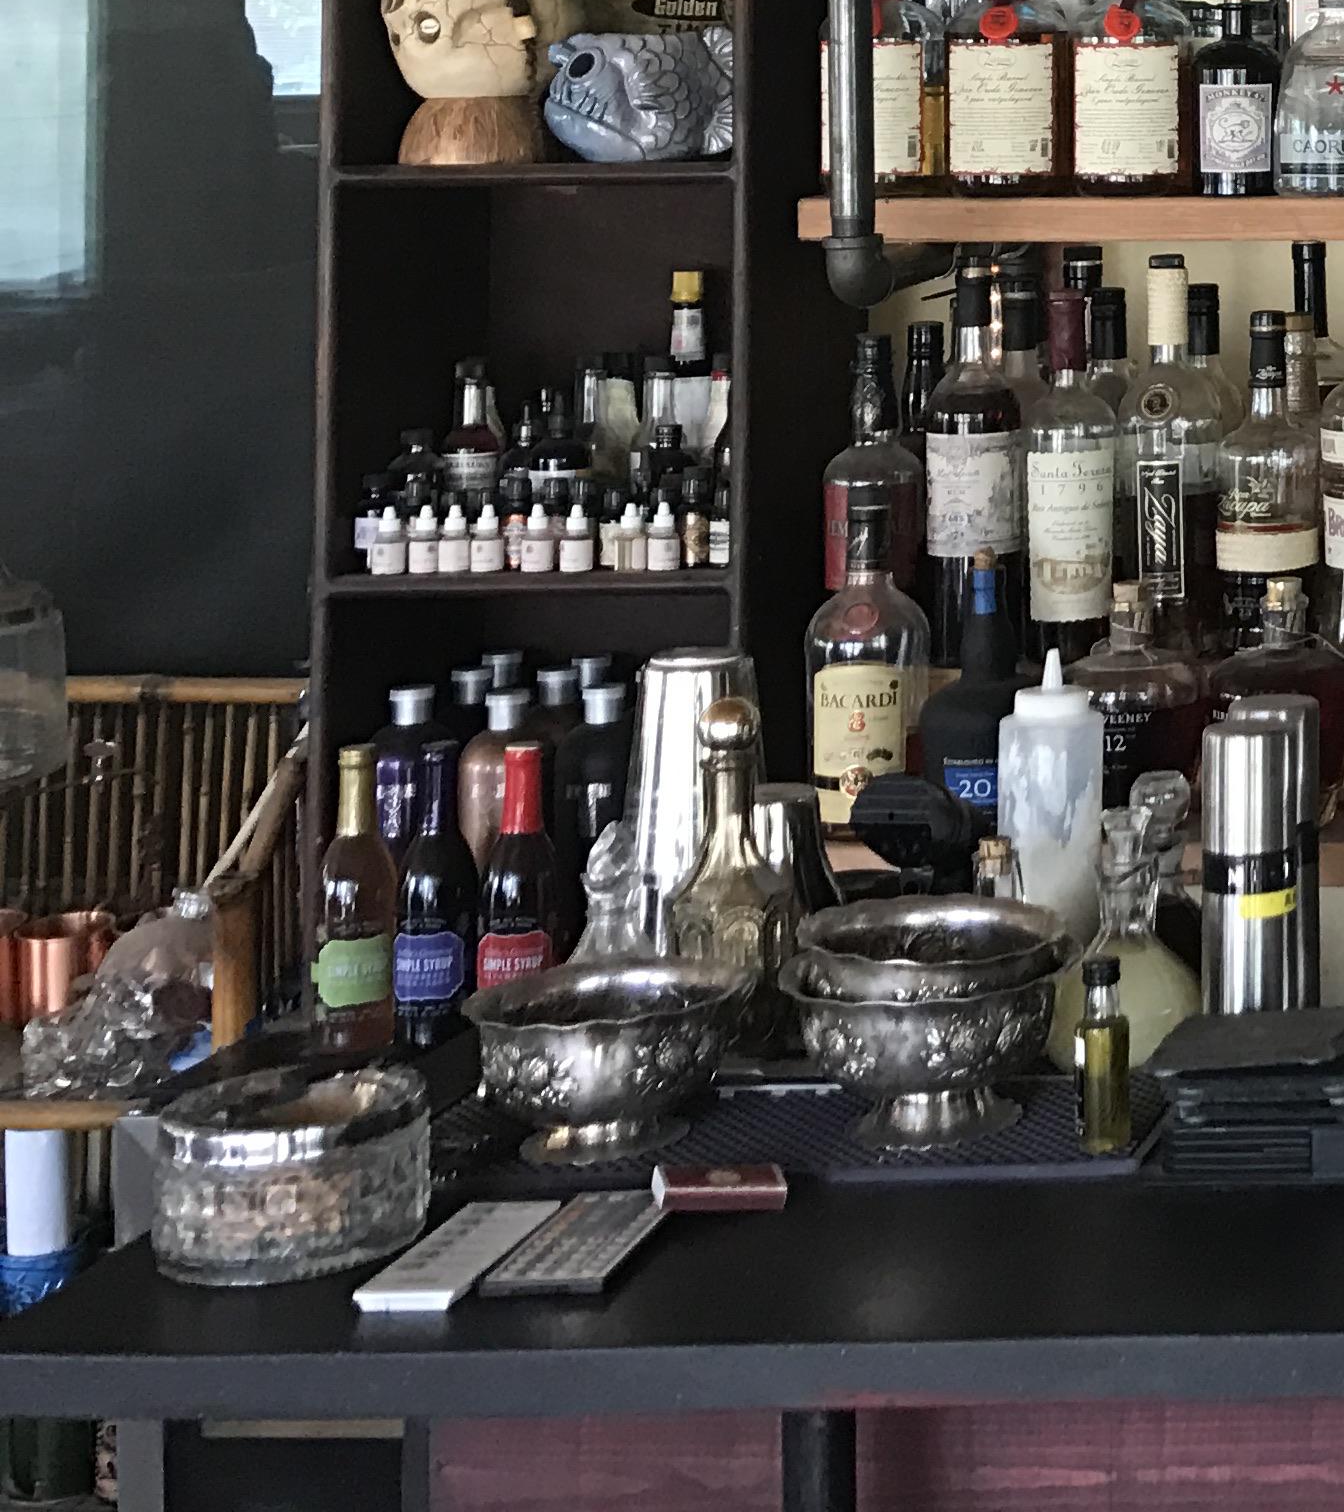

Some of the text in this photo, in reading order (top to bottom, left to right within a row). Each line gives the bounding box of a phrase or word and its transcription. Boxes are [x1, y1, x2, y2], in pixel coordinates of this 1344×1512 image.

[1030, 462, 1068, 478] Santa
[959, 778, 992, 798] 20
[514, 954, 543, 969] SYRUP
